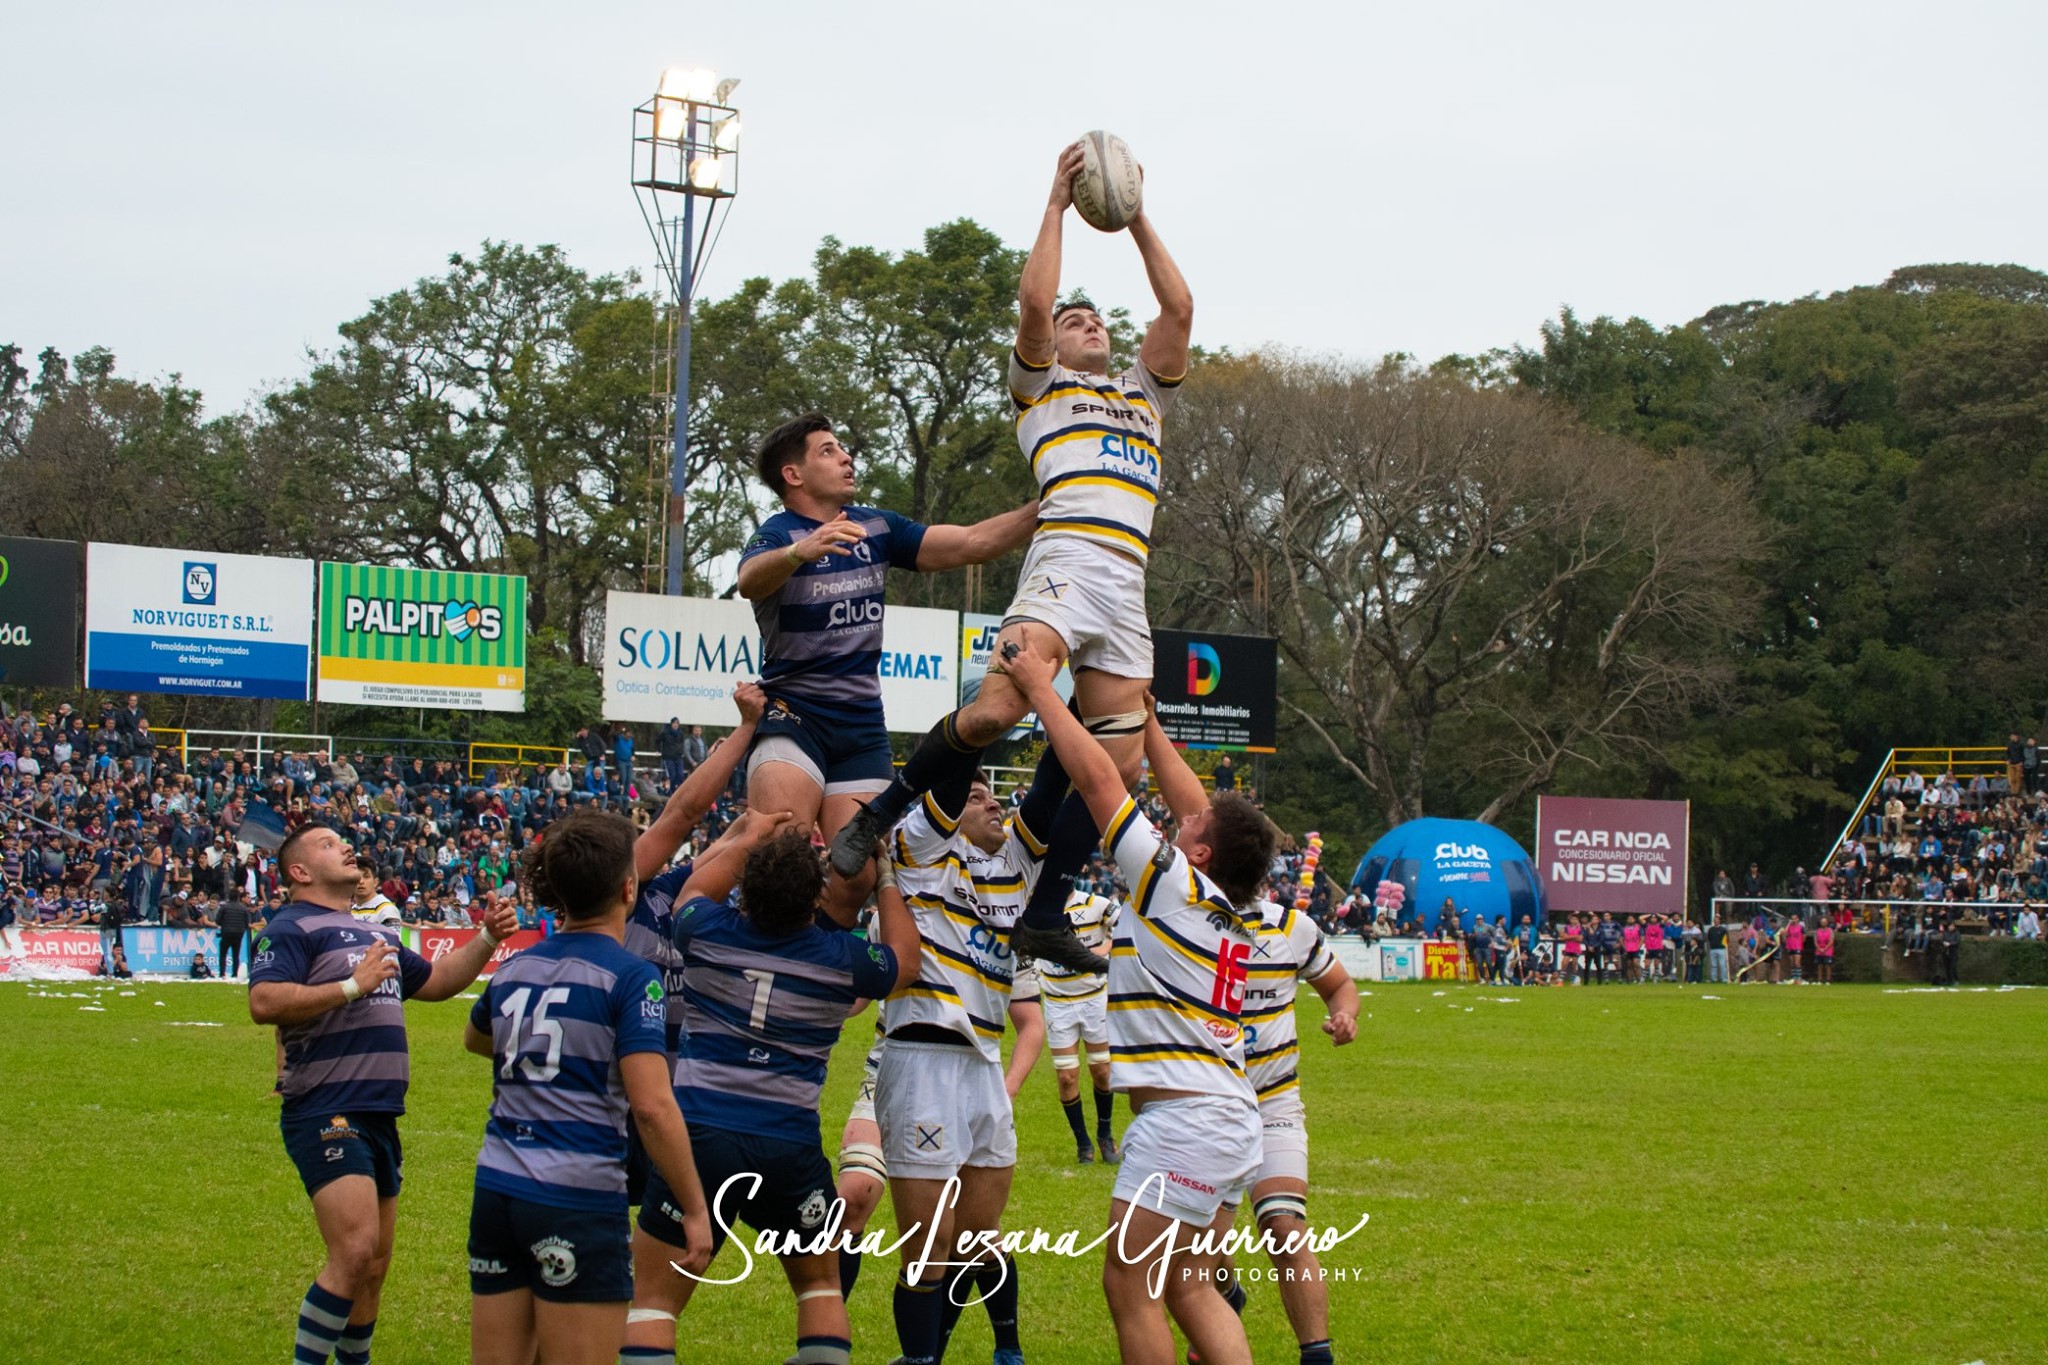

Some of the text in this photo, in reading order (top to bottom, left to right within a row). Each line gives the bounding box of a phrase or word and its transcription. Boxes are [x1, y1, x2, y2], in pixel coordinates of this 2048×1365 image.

[133, 609, 273, 632] NORVIGUET S.R.L.
[826, 599, 883, 629] Club
[151, 641, 250, 656] Premoldeados y Pretensados
[178, 654, 188, 663] de
[159, 676, 243, 689] WWW.NORVIGUET.COM.AR
[1156, 701, 1250, 718] Desarrollos Inmobiliarios
[1554, 829, 1671, 849] CAR NOA
[1433, 842, 1490, 861] Club
[1558, 849, 1668, 862] CONCESIONARIO OFICIAL
[1437, 861, 1492, 869] LA GACETA
[1552, 862, 1672, 885] NISSAN
[63, 941, 104, 955] NOA
[162, 929, 217, 955] MAX
[1211, 937, 1251, 1015] 16
[500, 986, 572, 1082] 15
[1167, 1171, 1217, 1195] NISSAN
